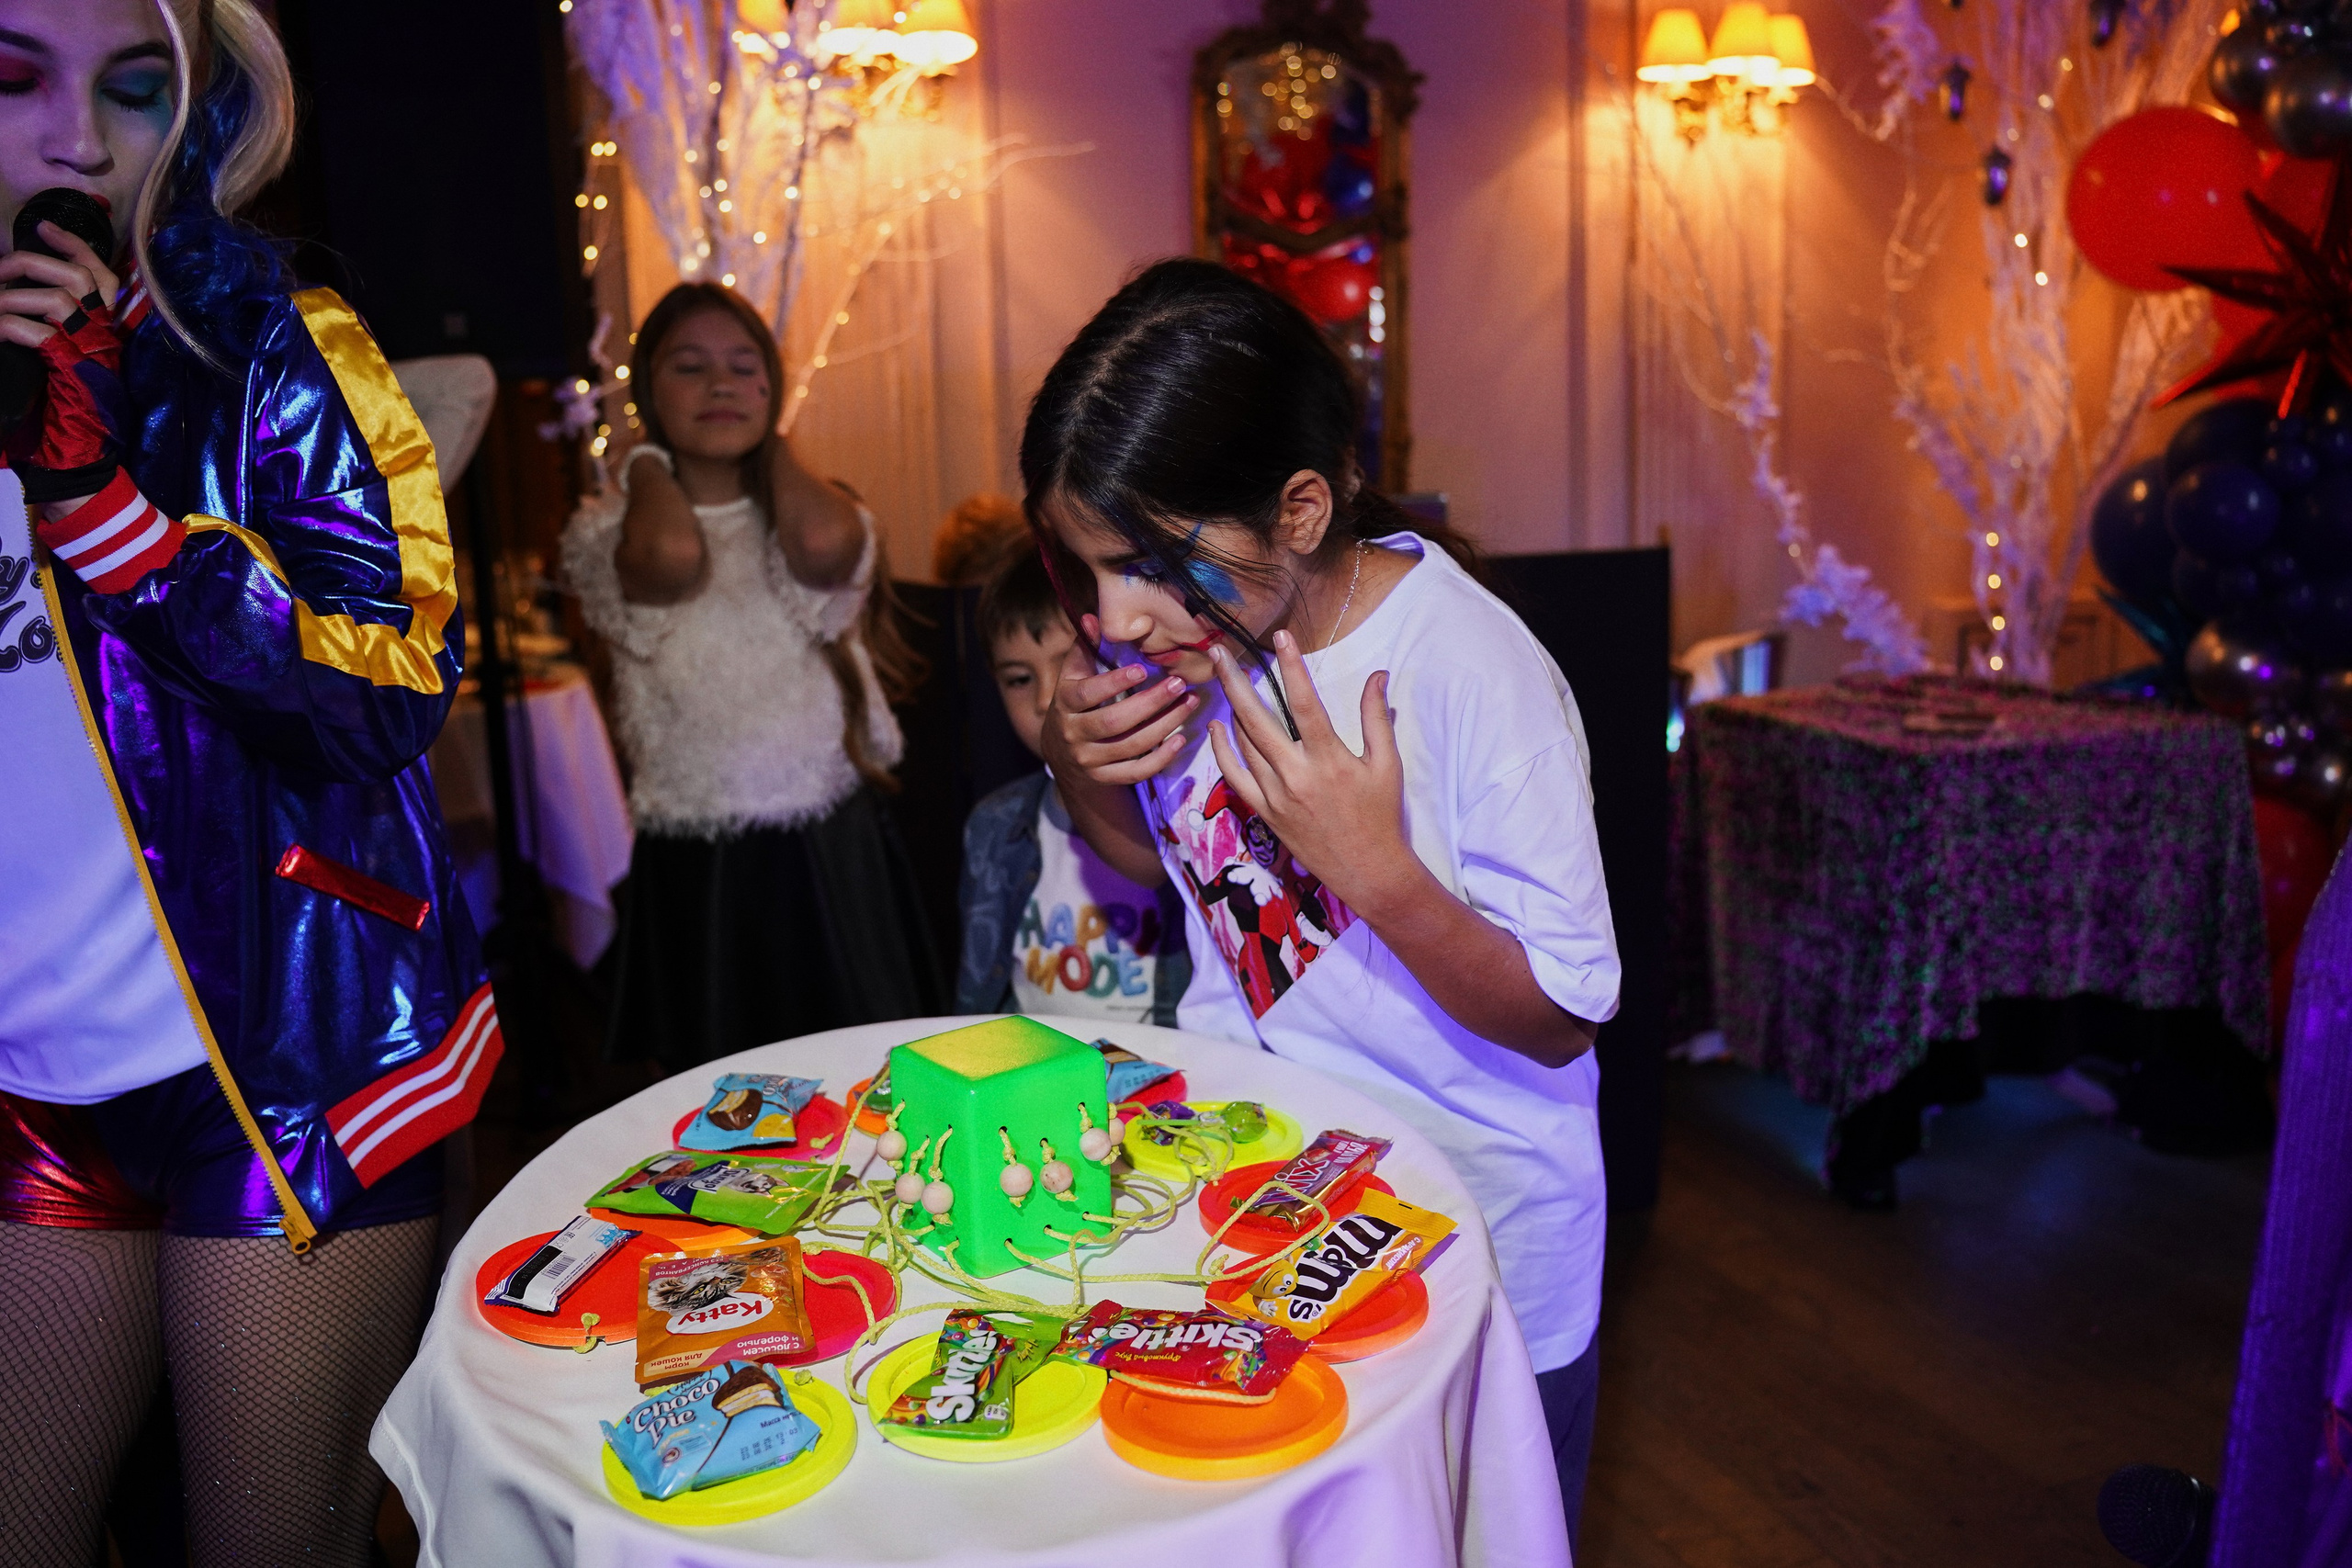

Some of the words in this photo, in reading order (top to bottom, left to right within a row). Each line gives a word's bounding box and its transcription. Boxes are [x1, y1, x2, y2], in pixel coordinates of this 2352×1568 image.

[1025, 945, 1148, 999] MODE
[1385, 1239, 1416, 1271] АРАХИСОМ
[678, 1300, 763, 1325] Katty
[737, 1335, 789, 1348] форелью
[1087, 1322, 1262, 1351] Skittles
[650, 1357, 684, 1367] кошек
[664, 1361, 689, 1370] корм
[925, 1329, 998, 1423] Skittles
[633, 1378, 720, 1434] Choco
[647, 1409, 696, 1450] Pie
[760, 1417, 781, 1428] Масса
